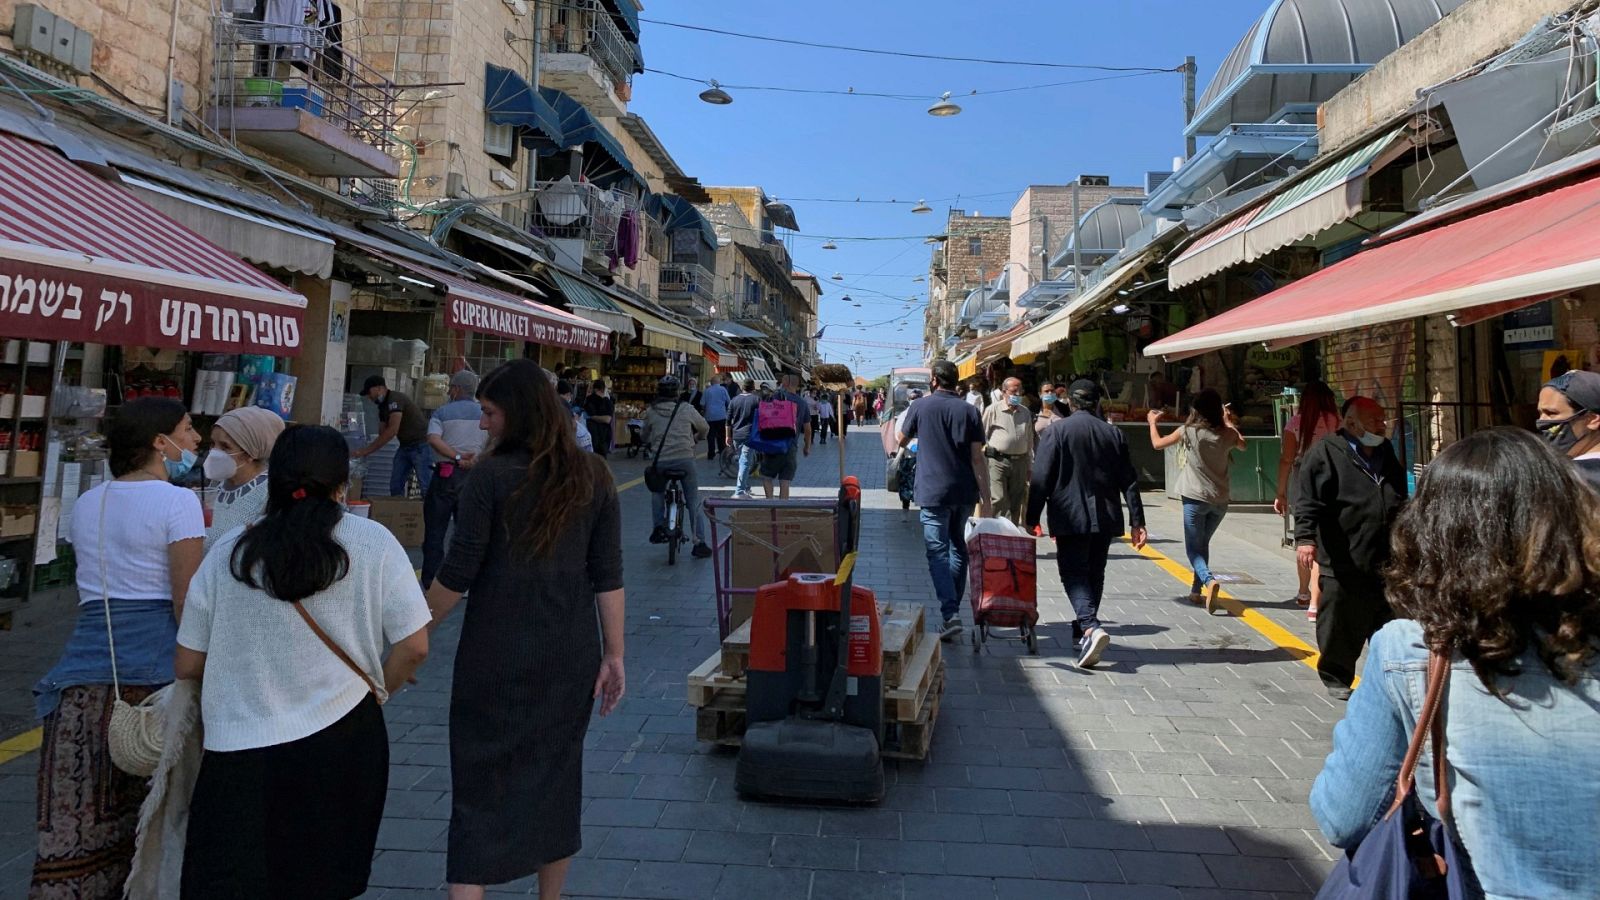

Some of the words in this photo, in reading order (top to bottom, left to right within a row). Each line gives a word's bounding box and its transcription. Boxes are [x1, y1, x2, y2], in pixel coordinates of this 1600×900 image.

[95, 288, 132, 332] רק
[160, 298, 300, 348] סופרמרקט
[452, 299, 529, 336] SUPERMARKET
